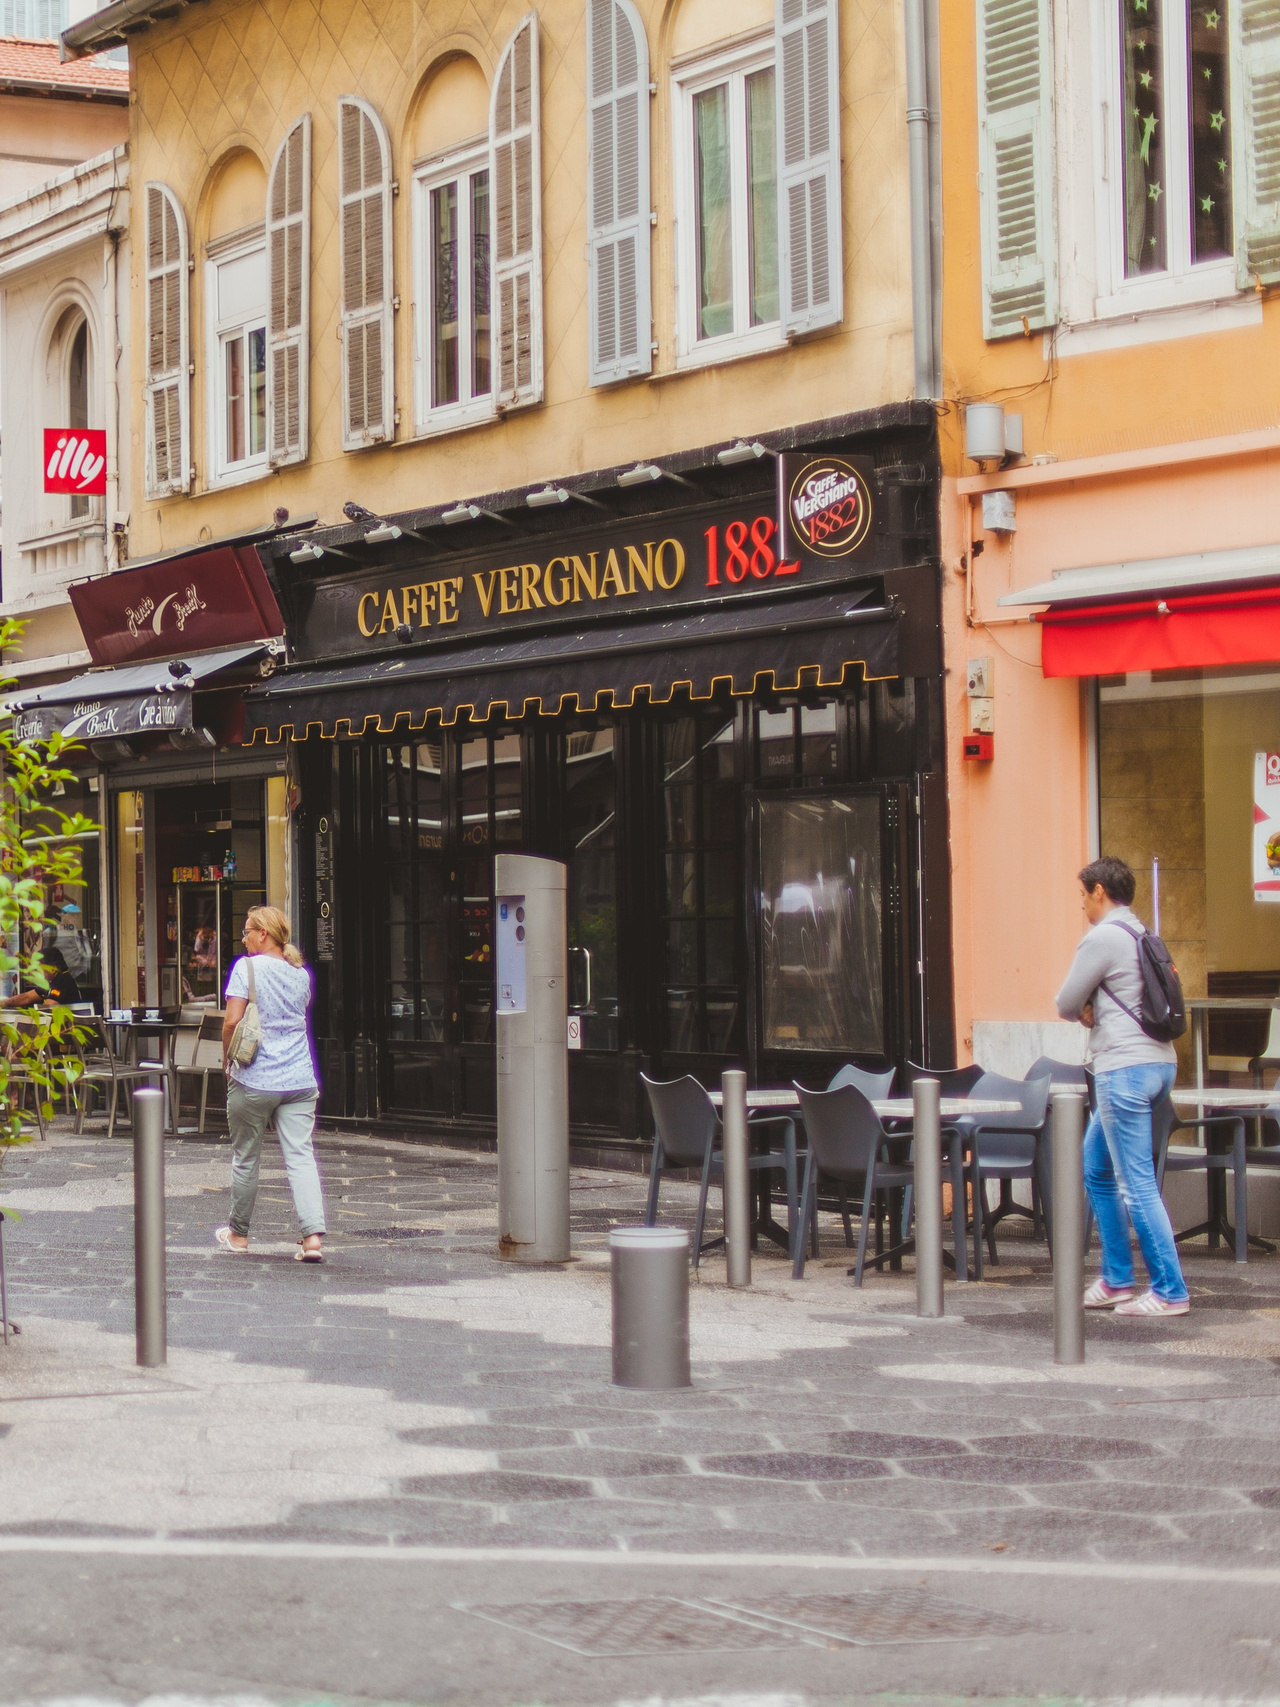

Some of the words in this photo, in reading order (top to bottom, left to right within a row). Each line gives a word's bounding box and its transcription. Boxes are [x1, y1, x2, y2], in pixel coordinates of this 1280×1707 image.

[46, 436, 106, 489] illy
[794, 476, 857, 521] VERGNANO
[808, 496, 858, 545] 1882
[472, 537, 686, 619] VERGNANO
[124, 596, 155, 638] Punto
[72, 700, 101, 718] Punto
